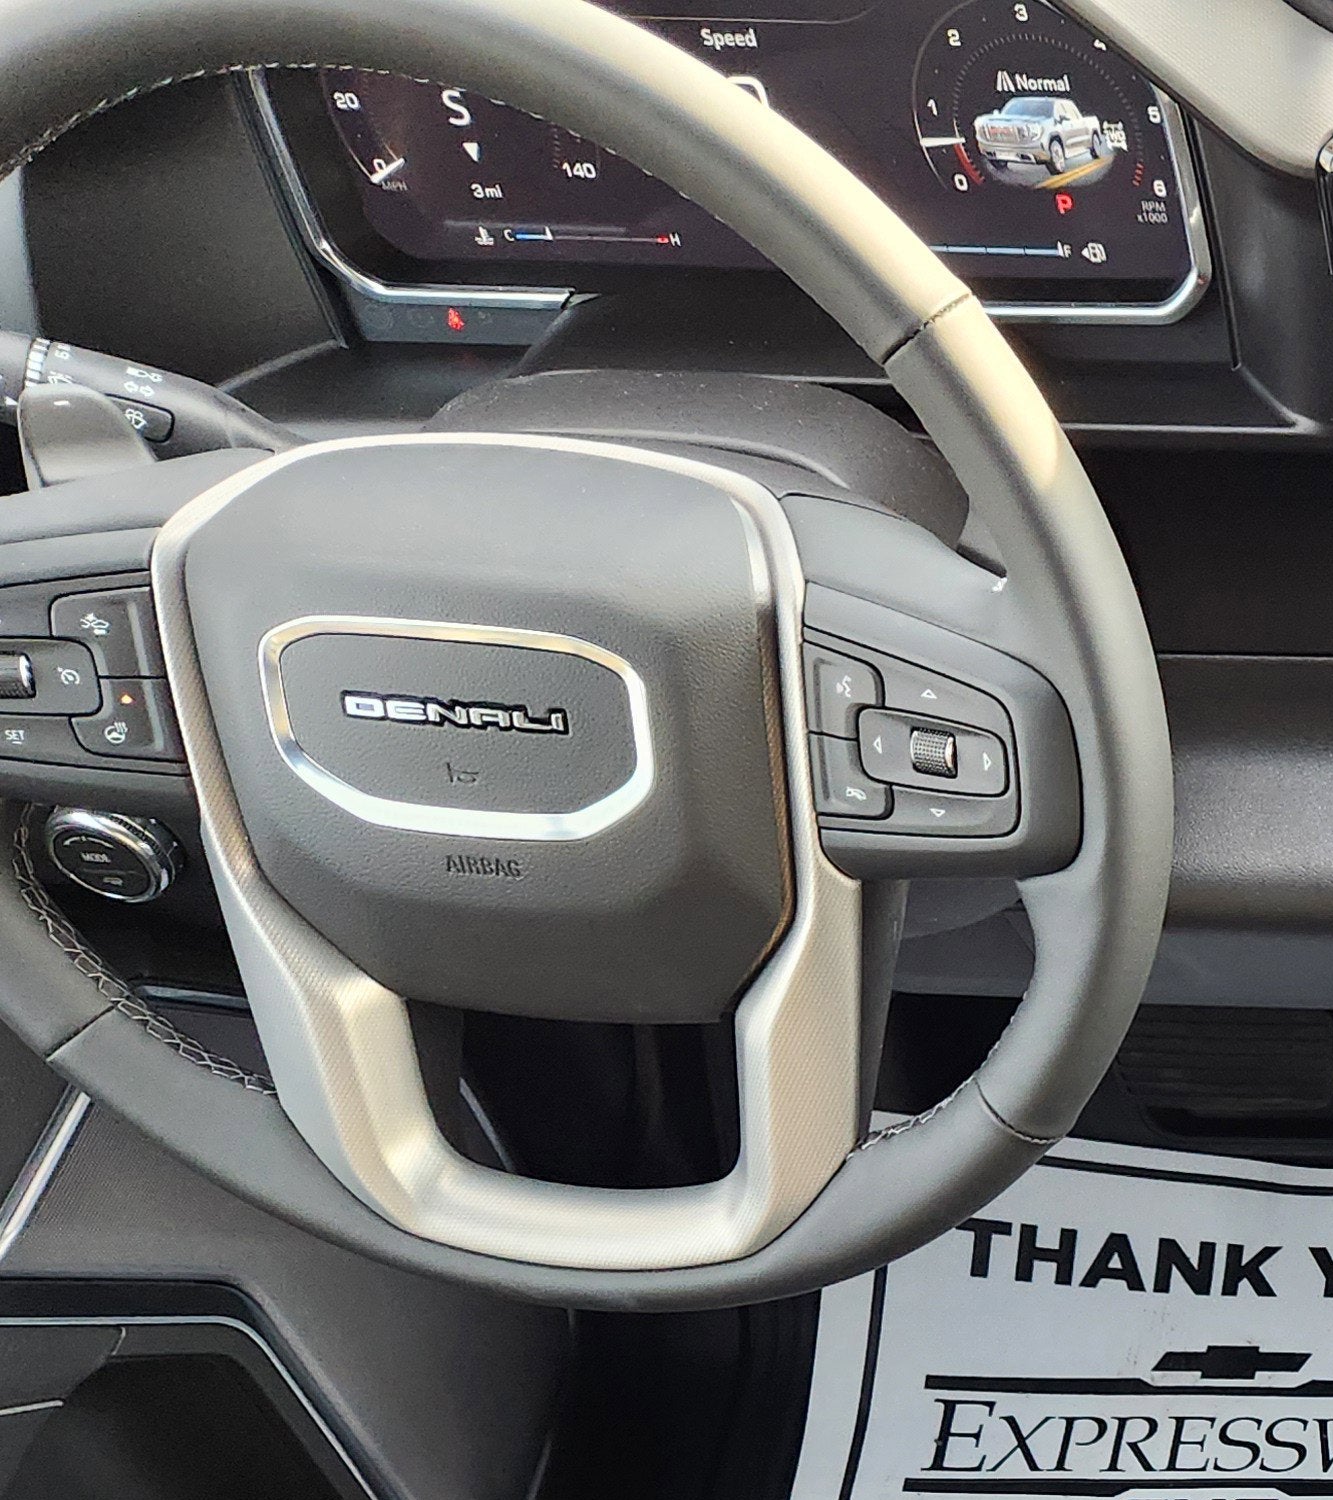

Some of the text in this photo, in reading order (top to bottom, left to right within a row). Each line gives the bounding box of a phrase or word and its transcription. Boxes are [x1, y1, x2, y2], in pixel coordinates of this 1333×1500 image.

[1015, 3, 1029, 21] 3
[701, 29, 757, 49] Speed
[947, 29, 961, 47] 2
[1016, 74, 1070, 92] Normal
[333, 92, 359, 110] 20
[928, 99, 939, 115] 1
[562, 162, 597, 179] 140
[953, 174, 969, 192] 0
[1153, 179, 1167, 197] 6
[1055, 194, 1074, 214] P
[1142, 201, 1166, 212] RPM
[344, 694, 566, 734] DENALI
[5, 729, 25, 741] SET
[445, 853, 524, 879] AIRBAG
[955, 1217, 1284, 1298] THANK
